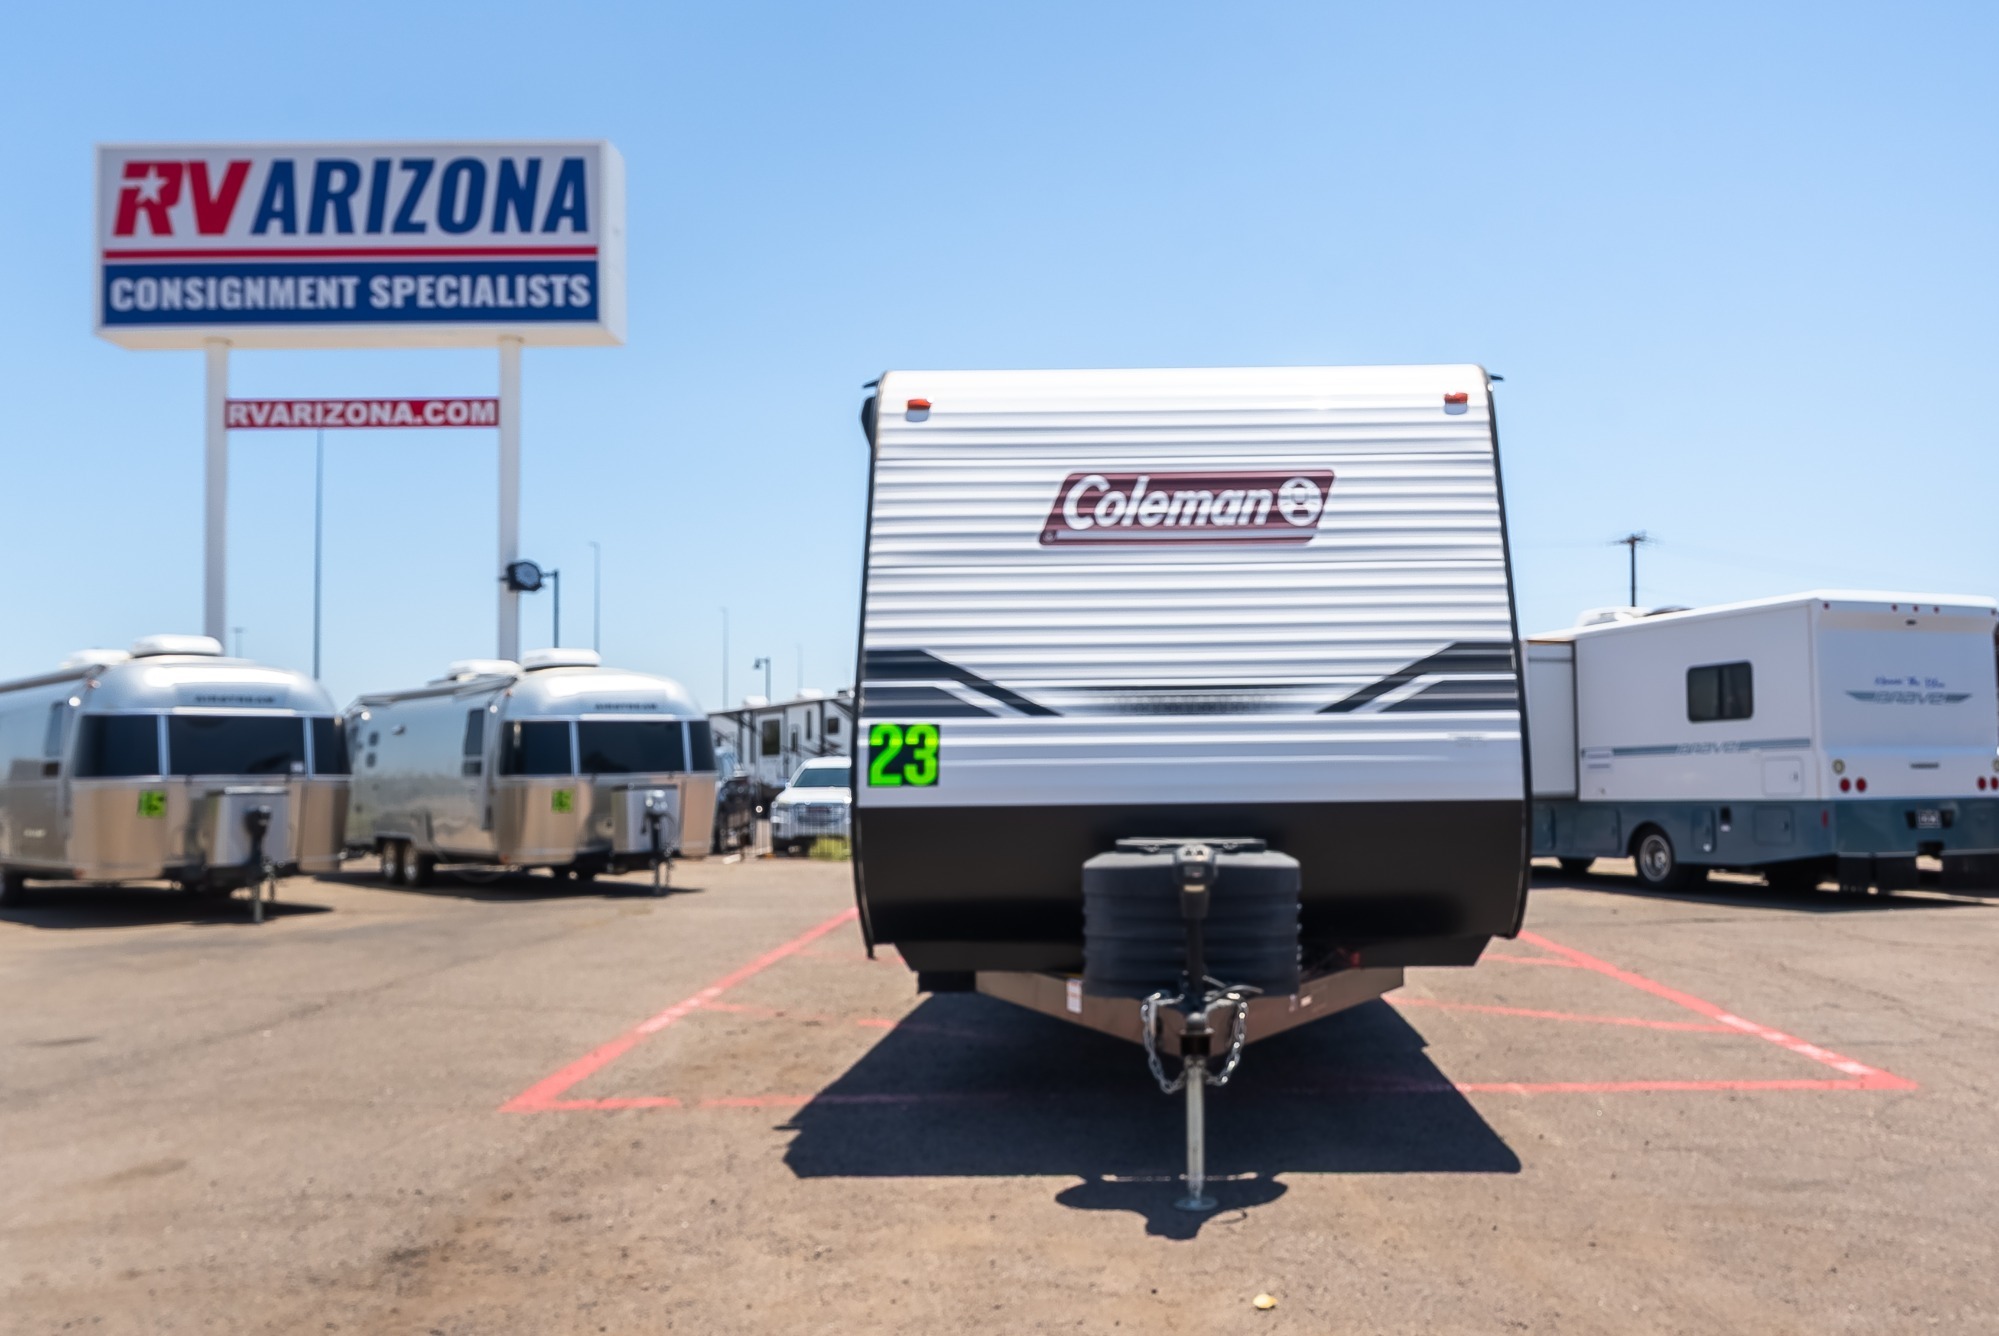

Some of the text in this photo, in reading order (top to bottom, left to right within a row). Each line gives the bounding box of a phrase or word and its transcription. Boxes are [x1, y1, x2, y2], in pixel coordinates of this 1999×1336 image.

[109, 274, 591, 312] CONSIGNMENT SPECIALISTS
[228, 400, 497, 428] RVARIZONA.COM
[1063, 474, 1273, 530] Coleman
[869, 723, 939, 786] 23
